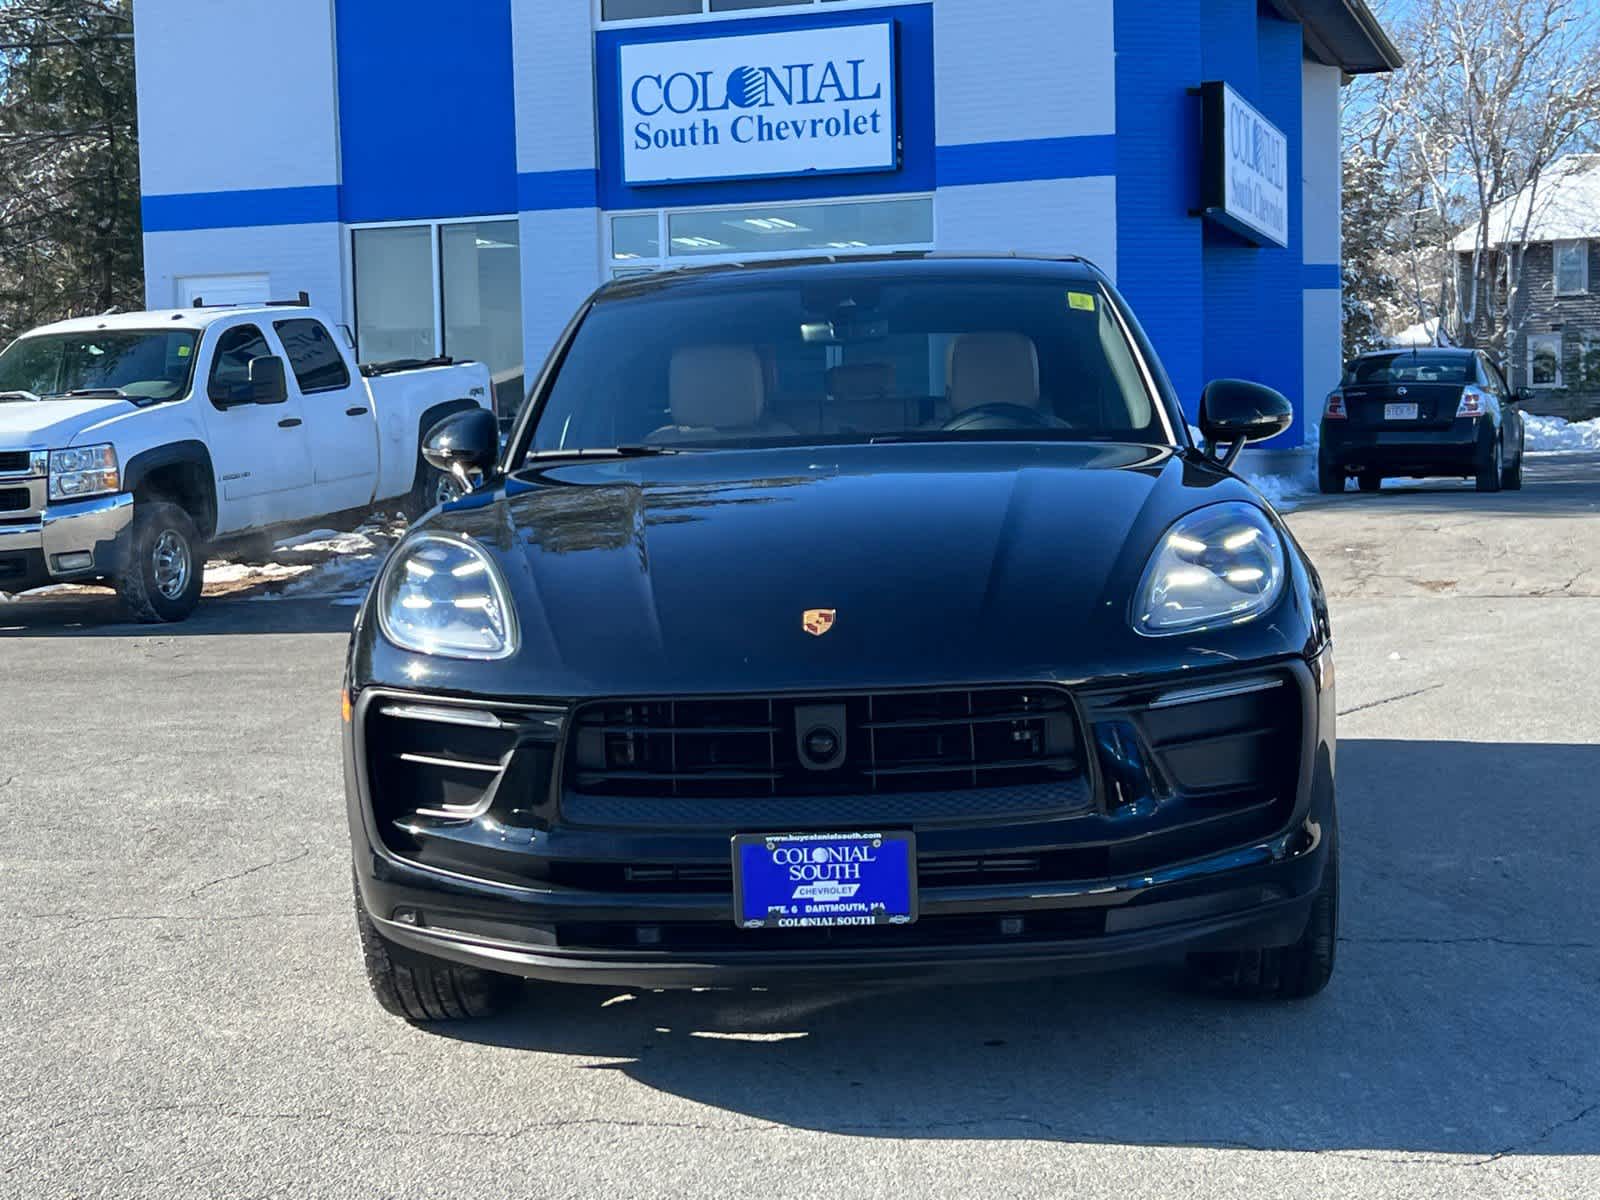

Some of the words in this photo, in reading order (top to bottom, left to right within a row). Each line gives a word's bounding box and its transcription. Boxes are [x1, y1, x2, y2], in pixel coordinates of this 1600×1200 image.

[631, 59, 881, 116] COLONIAL
[634, 119, 720, 150] South
[731, 109, 880, 143] Chevrolet
[766, 833, 882, 842] www.buycolonialsouth.com
[773, 847, 876, 865] COLONIAL
[789, 864, 860, 881] SOUTH
[799, 886, 853, 896] CHEVROLET
[791, 905, 798, 914] 6
[805, 902, 868, 913] DARTMOUTH,
[778, 917, 836, 928] COLONIAL
[837, 916, 875, 926] SOUTH
